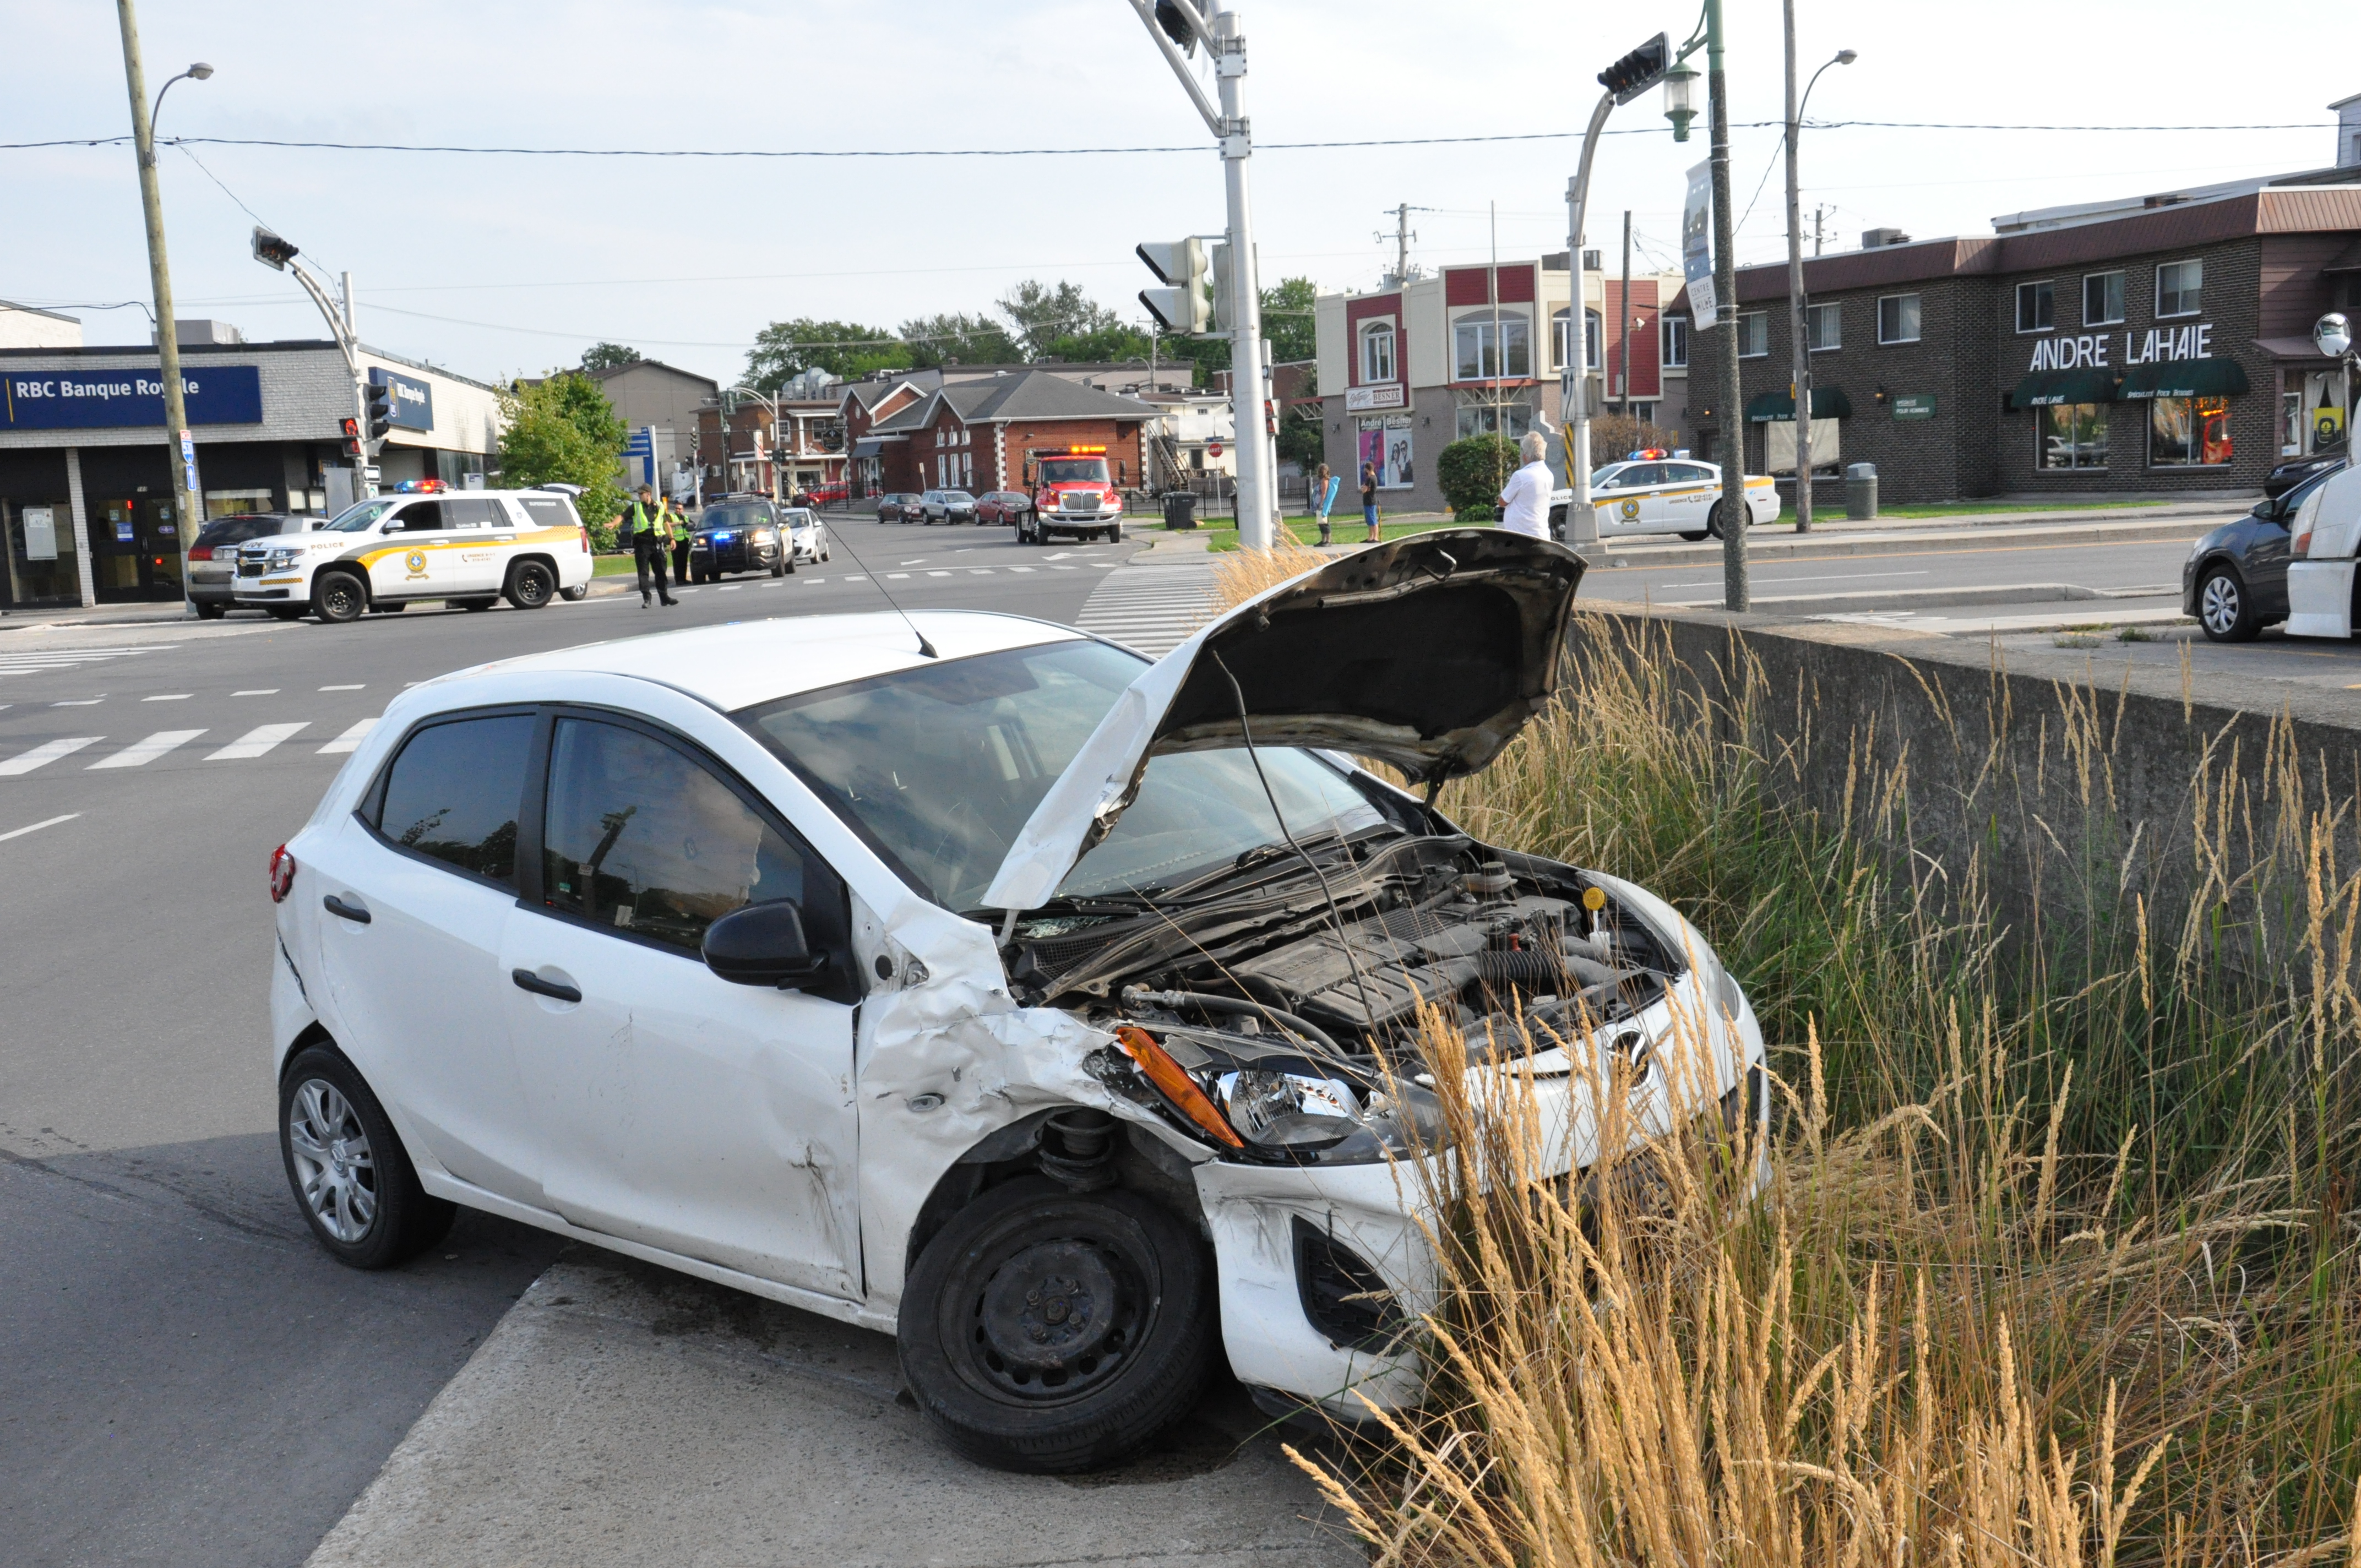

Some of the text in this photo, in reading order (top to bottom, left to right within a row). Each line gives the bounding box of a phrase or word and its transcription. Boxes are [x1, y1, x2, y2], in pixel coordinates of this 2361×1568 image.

[1691, 282, 1710, 297] CENTRE
[2030, 324, 2213, 372] ANDRE LAHAIE
[16, 378, 199, 400] RBC Banque Royle
[1373, 391, 1401, 401] BESNER
[1361, 419, 1382, 427] André
[1386, 417, 1411, 426] Besner
[183, 441, 193, 455] 530
[311, 542, 345, 550] POLICE
